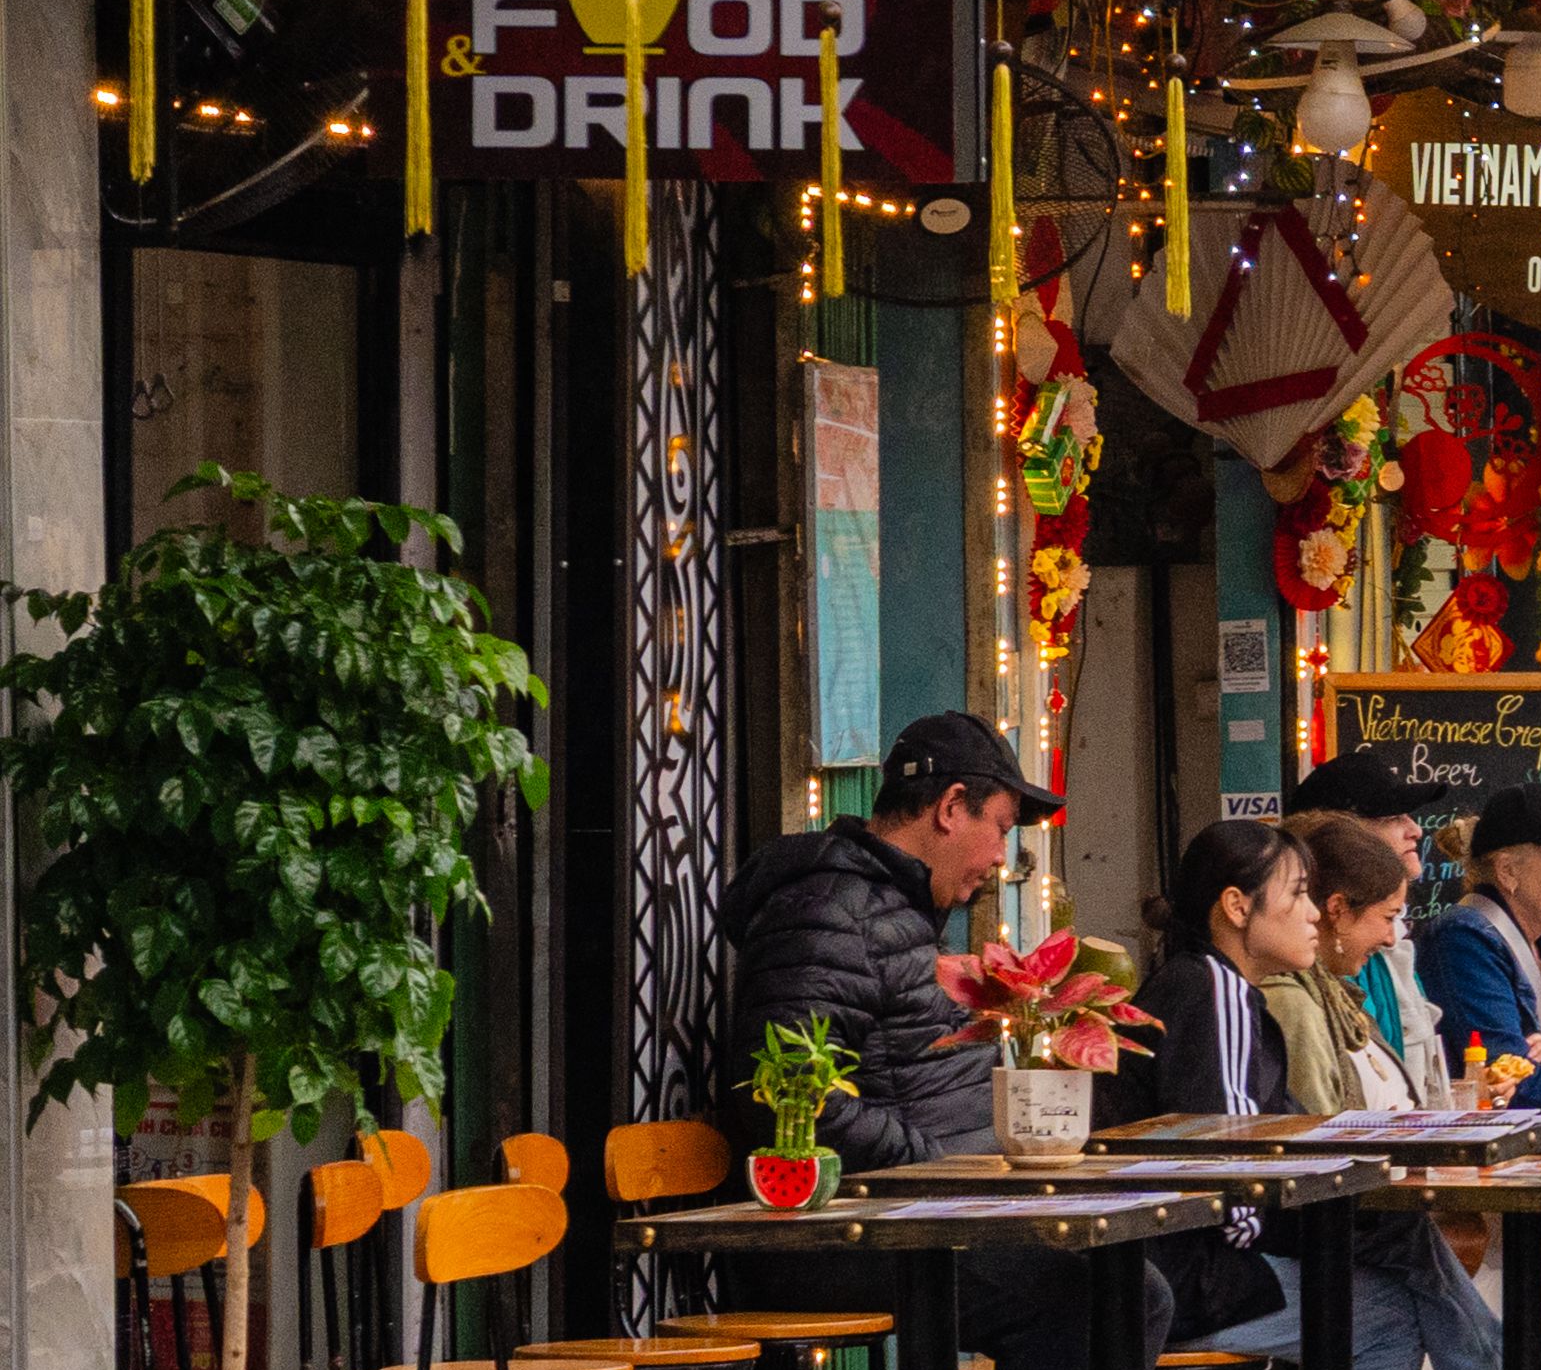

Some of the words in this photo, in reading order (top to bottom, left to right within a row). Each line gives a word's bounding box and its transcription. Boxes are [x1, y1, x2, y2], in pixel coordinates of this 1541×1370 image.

[440, 34, 487, 78] &
[471, 75, 866, 151] DRINK
[1336, 693, 1493, 745] Vietnamese
[1406, 742, 1483, 787] Beer
[1227, 796, 1280, 816] VISA
